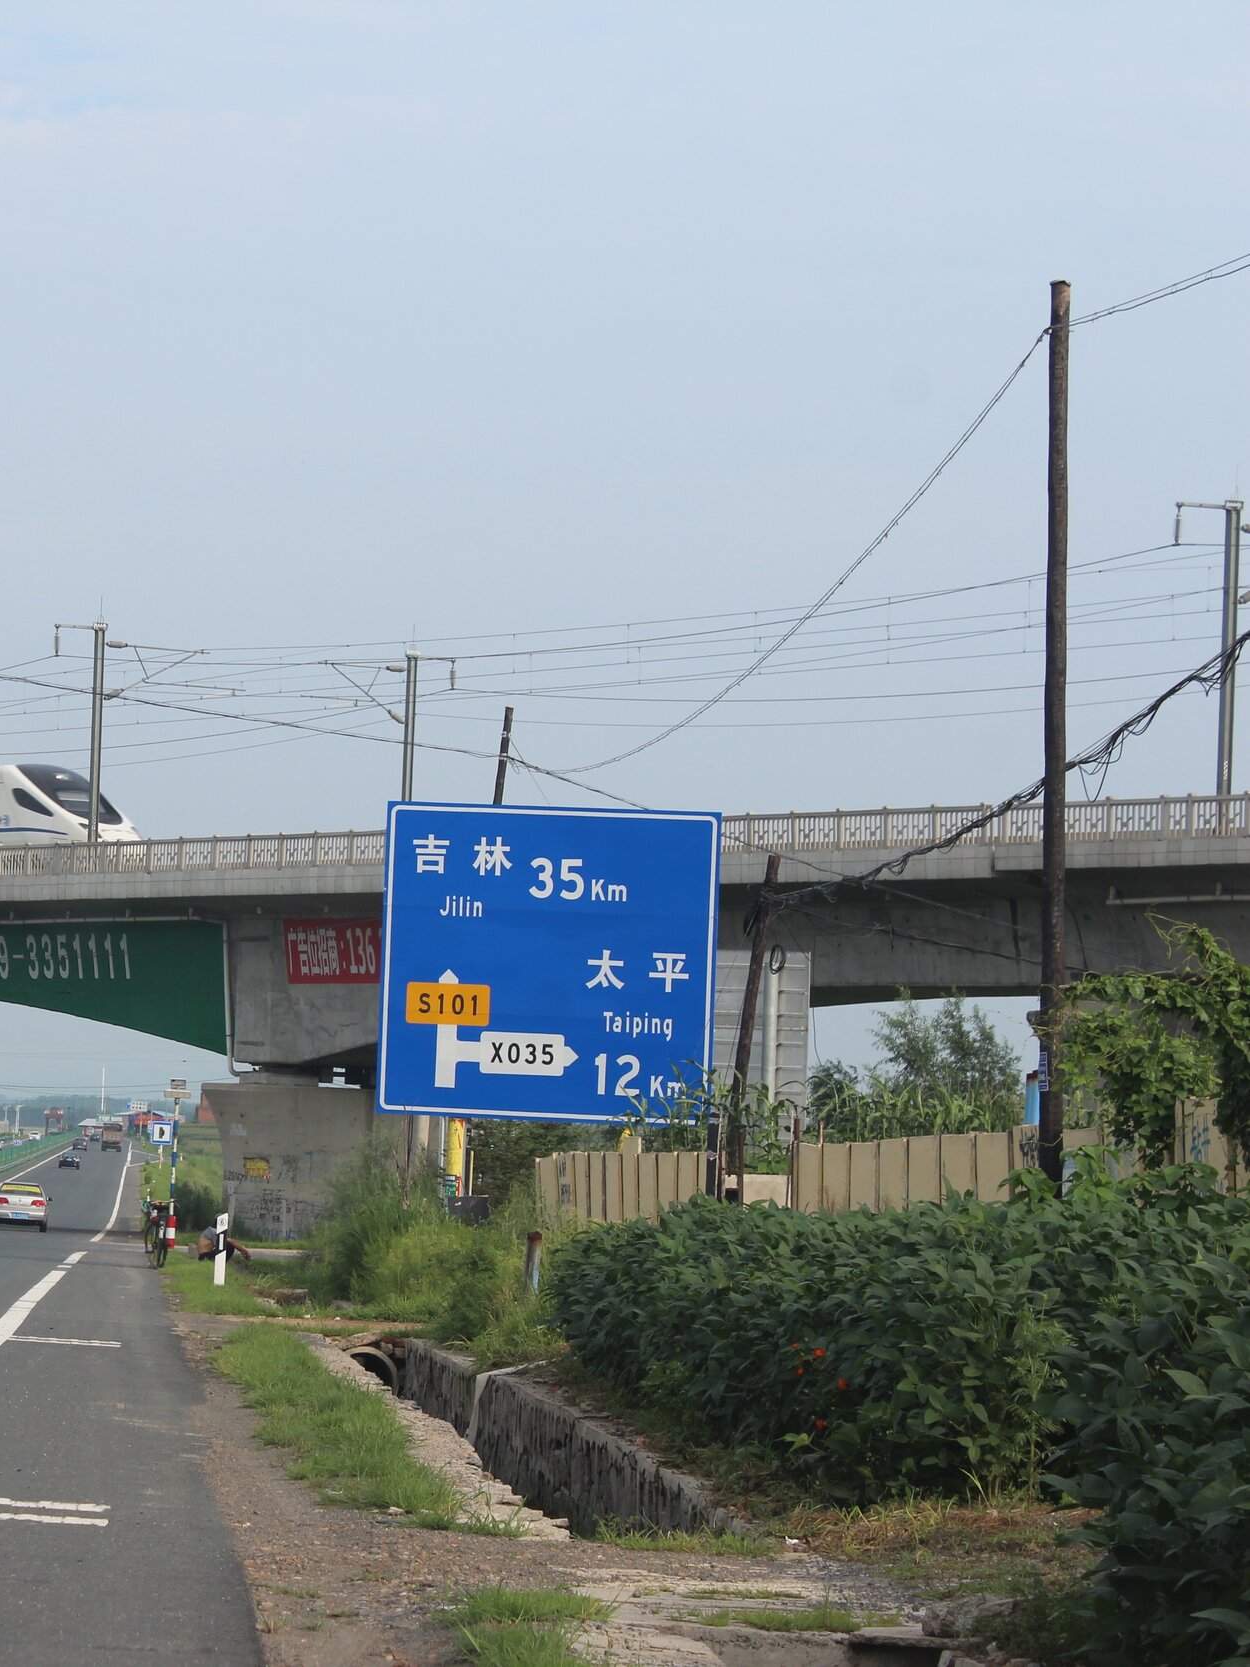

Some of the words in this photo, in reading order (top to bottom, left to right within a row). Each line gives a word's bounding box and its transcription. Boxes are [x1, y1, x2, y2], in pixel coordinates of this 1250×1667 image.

[413, 834, 512, 876] 吉林
[440, 896, 483, 918] Jilin
[585, 950, 689, 992] 太平
[418, 993, 478, 1016] S101
[603, 1011, 673, 1041] Taiping
[490, 1042, 554, 1065] X035
